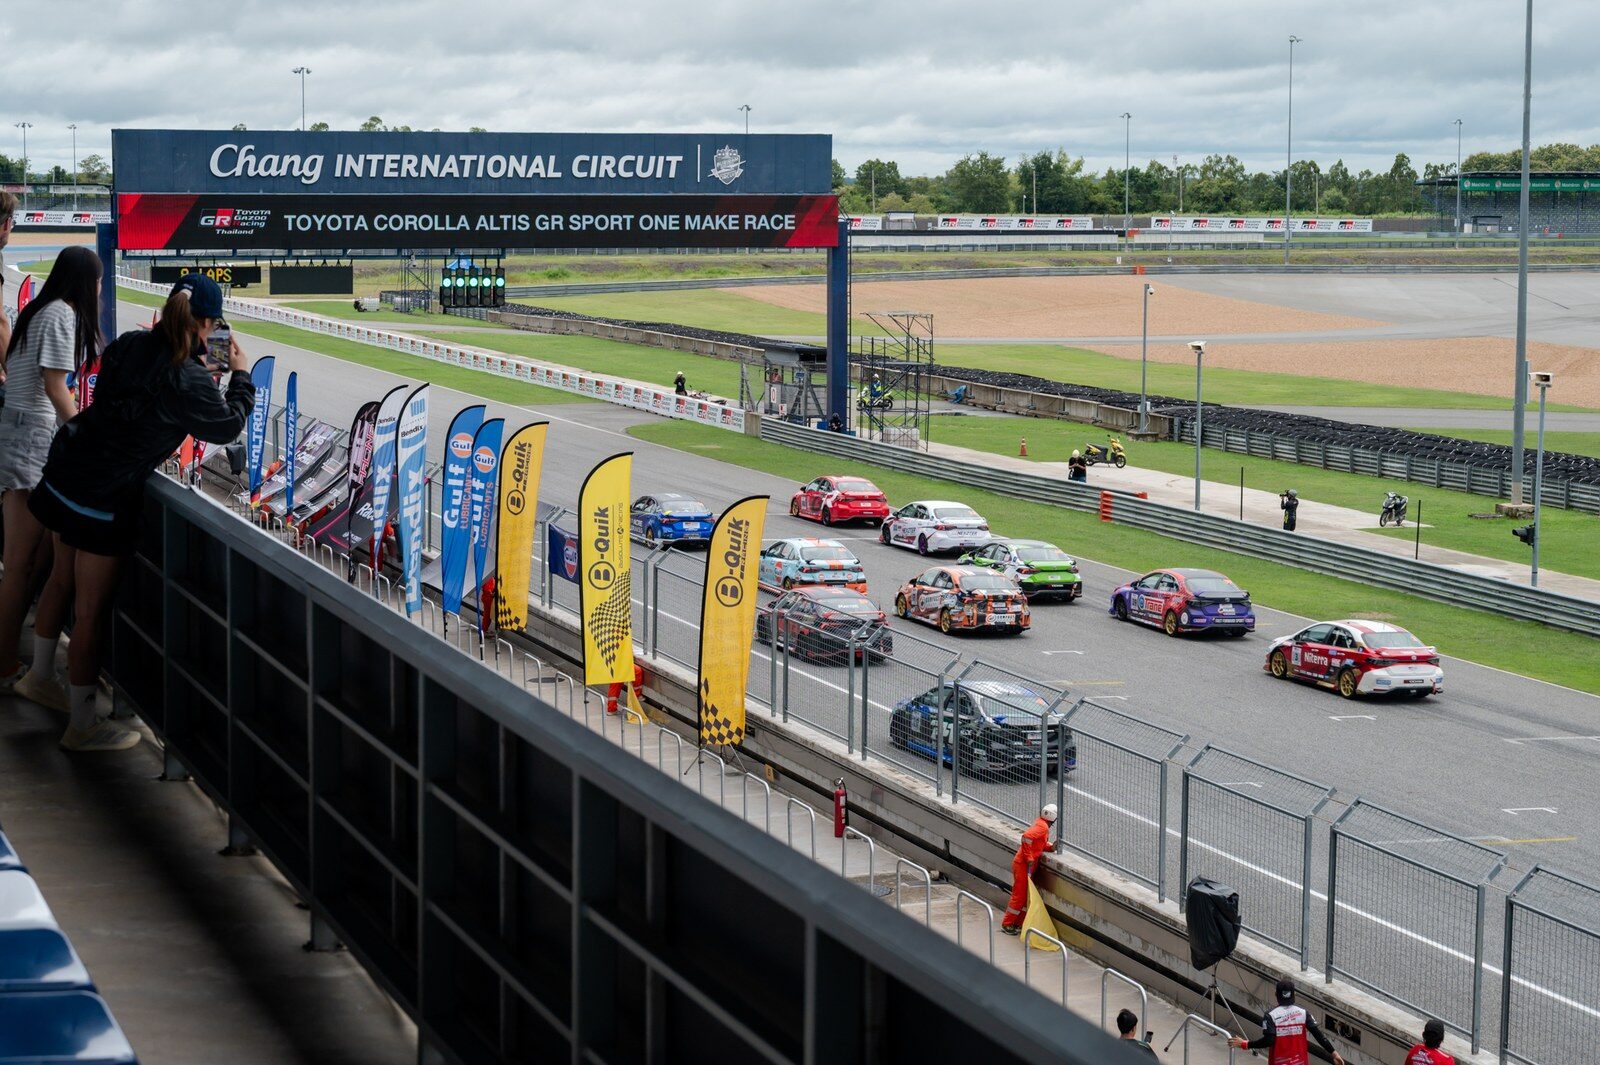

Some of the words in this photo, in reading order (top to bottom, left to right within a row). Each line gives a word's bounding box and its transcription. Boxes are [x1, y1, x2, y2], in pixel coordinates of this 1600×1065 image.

[209, 144, 324, 184] Chang
[335, 154, 562, 179] INTERNATIONAL
[572, 155, 683, 179] CIRCUIT
[200, 215, 231, 226] GR
[284, 214, 368, 231] TOYOTA
[373, 214, 471, 231] COROLLA
[475, 214, 530, 231] ALTIS
[535, 214, 564, 231] GR
[568, 214, 634, 231] SPORT
[639, 214, 679, 231] ONE
[685, 214, 739, 231] MAKE
[745, 214, 796, 231] RACE
[401, 425, 423, 438] Bendix
[452, 441, 473, 450] Gul
[475, 453, 495, 466] Gulf
[510, 441, 527, 509] B-Quik
[444, 463, 464, 529] Gulf
[480, 482, 493, 548] LUBRICANTS
[594, 506, 610, 582] B-Quik
[720, 516, 744, 599] B-Quik
[1304, 651, 1328, 666] Niterra
